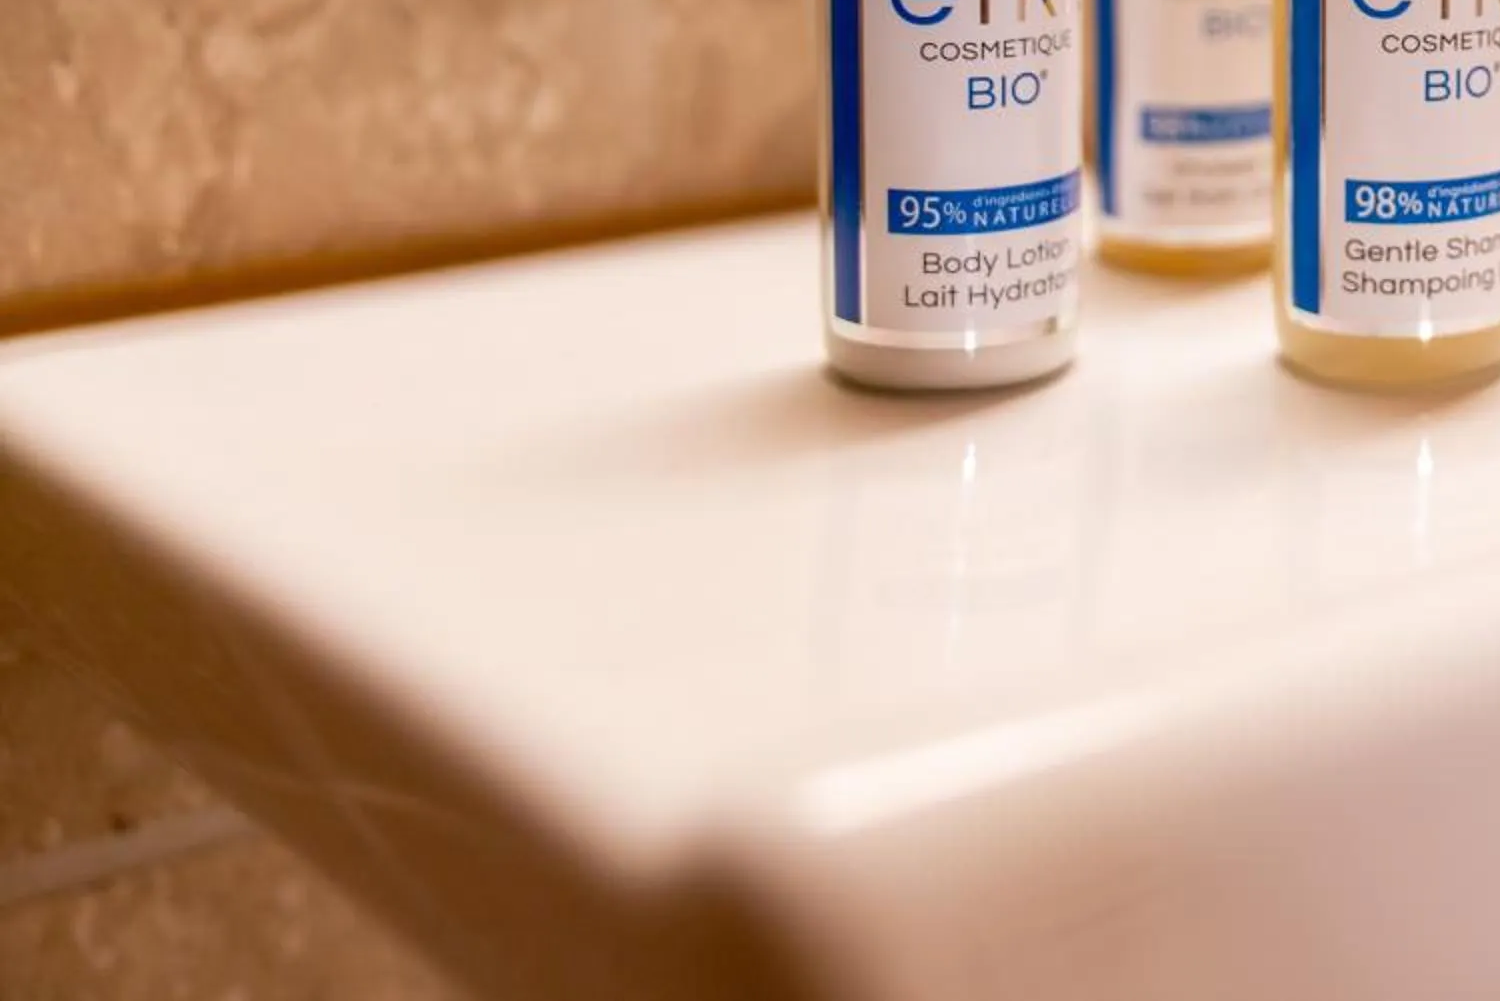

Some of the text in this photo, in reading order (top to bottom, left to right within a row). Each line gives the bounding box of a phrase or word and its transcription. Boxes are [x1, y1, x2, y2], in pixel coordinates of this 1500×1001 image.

[900, 195, 967, 229] 95%
[1355, 185, 1424, 219] 98%
[923, 250, 998, 277] Body
[1345, 238, 1438, 263] Gentle
[904, 284, 959, 308] Lait
[1342, 265, 1495, 299] Shampoing
